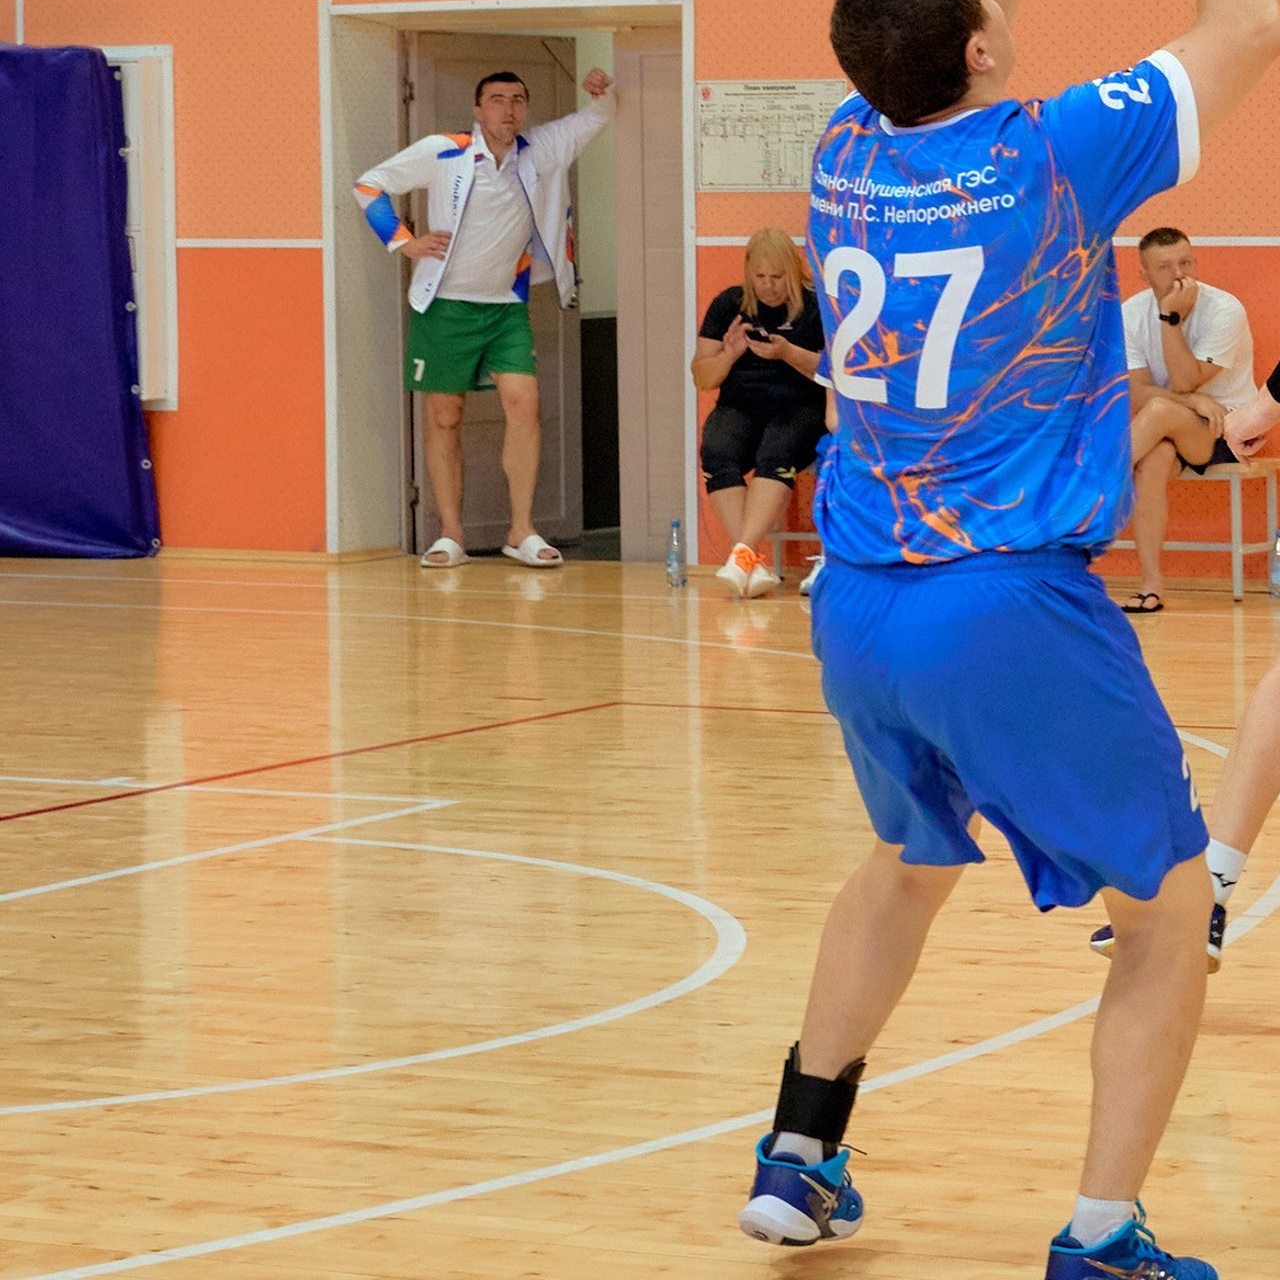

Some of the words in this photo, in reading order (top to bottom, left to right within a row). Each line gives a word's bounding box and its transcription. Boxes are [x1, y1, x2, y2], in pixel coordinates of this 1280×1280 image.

[1092, 68, 1152, 110] 2
[957, 166, 998, 190] ГЭС
[847, 202, 880, 222] П.С.
[884, 194, 1016, 226] Непорожнего
[823, 245, 984, 409] 27
[413, 358, 426, 382] 7
